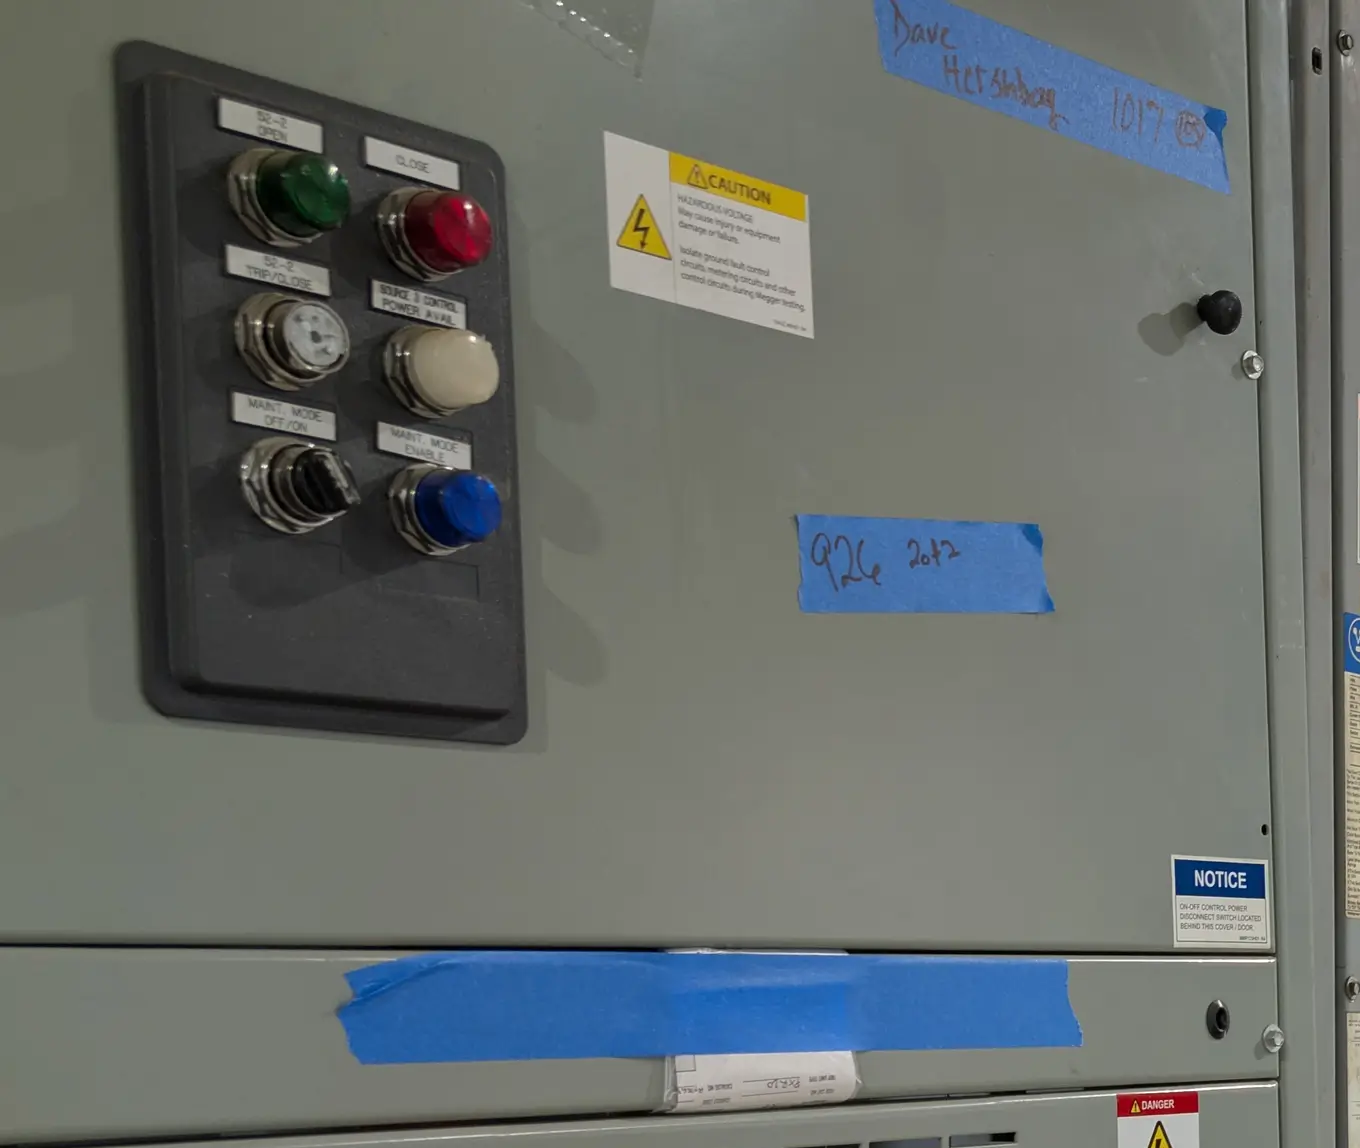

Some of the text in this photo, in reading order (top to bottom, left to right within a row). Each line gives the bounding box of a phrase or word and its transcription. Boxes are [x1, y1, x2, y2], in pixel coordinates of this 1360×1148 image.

[395, 155, 431, 174] CLOSE
[708, 174, 772, 205] CAUTION
[382, 298, 421, 316] POWER
[424, 295, 459, 314] CONTROL
[291, 406, 323, 423] MODE
[404, 443, 446, 464] ENABLE
[430, 438, 459, 454] MODE
[1194, 869, 1247, 889] NOTICE
[1180, 912, 1215, 921] DISCONNECT
[1201, 904, 1227, 912] CONTROL
[1215, 923, 1234, 931] COVER
[1141, 1099, 1175, 1110] DANGER
